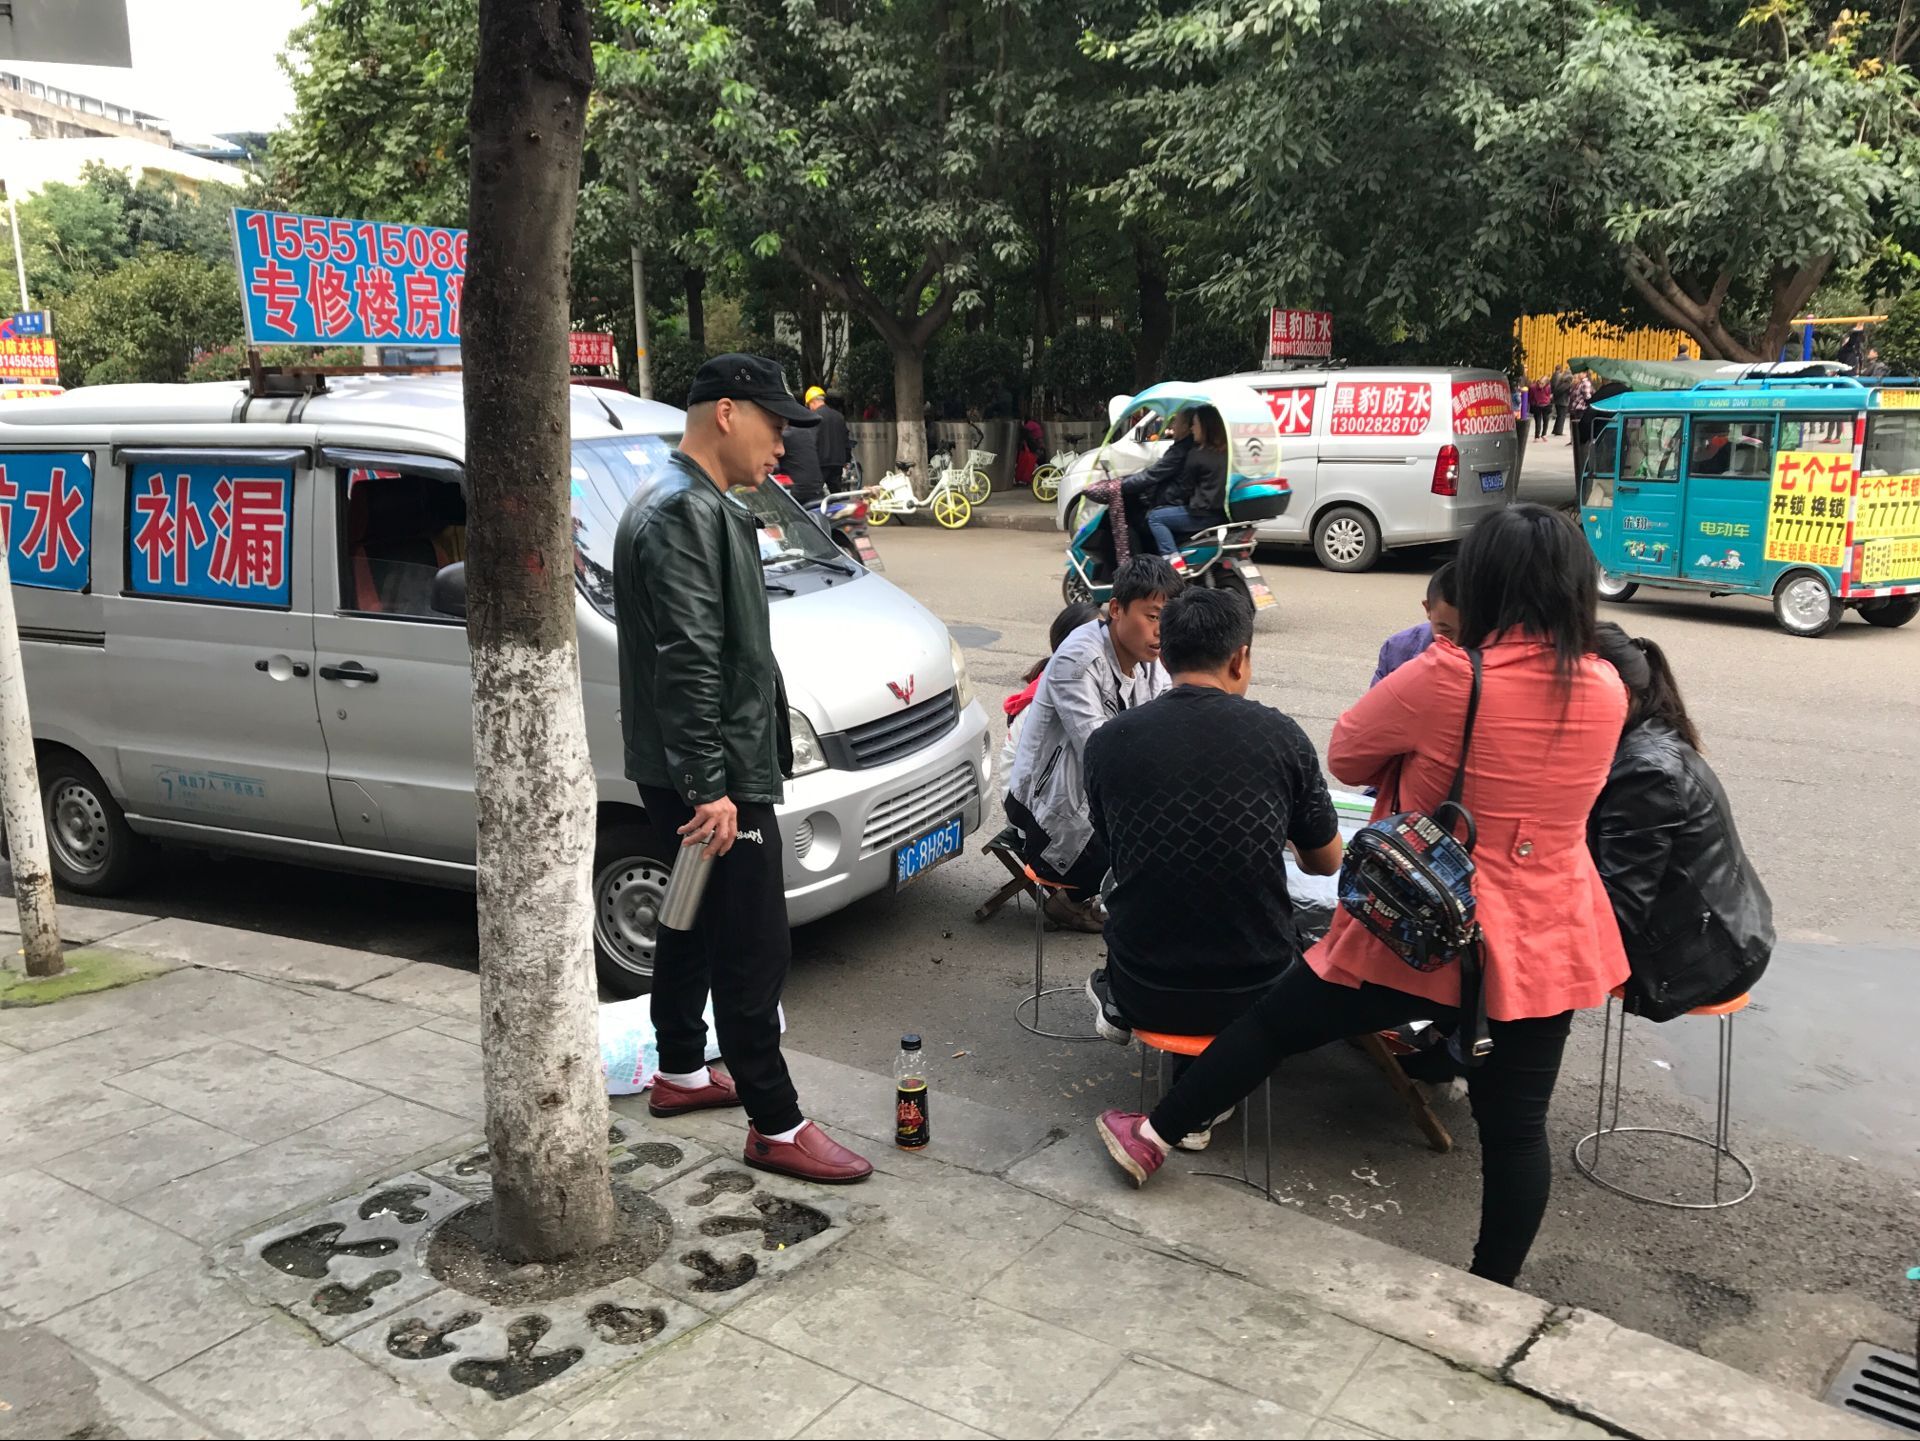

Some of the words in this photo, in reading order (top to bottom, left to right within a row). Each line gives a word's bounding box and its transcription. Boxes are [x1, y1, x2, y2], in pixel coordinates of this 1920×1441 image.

[1274, 311, 1331, 340] 黑豹防水
[1264, 391, 1311, 433] 水
[1333, 386, 1431, 415] 黑豹防水
[1332, 416, 1428, 433] 13002828702
[1778, 455, 1852, 493] 七个七
[0, 464, 84, 572] 水
[1773, 494, 1806, 516] 开锁
[1811, 496, 1846, 519] 换锁
[134, 473, 286, 590] 补漏
[1700, 521, 1750, 538] 电动车
[1775, 518, 1846, 545] 7777777
